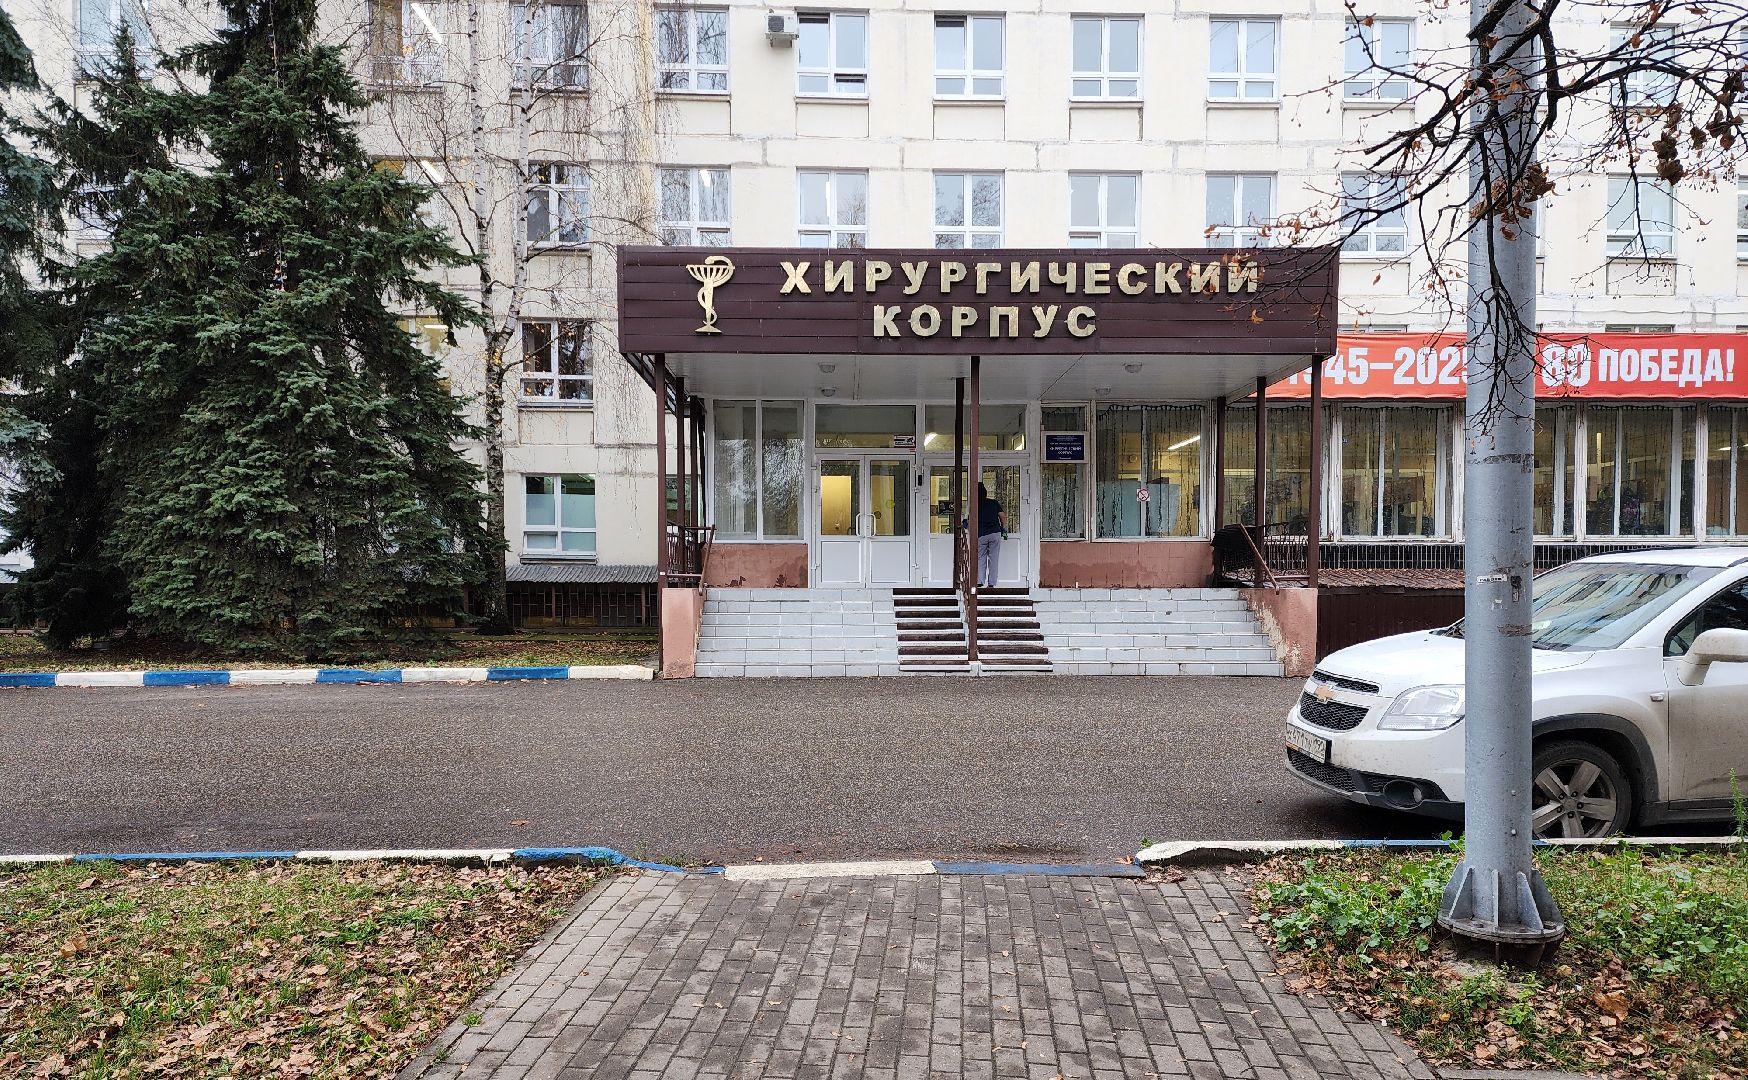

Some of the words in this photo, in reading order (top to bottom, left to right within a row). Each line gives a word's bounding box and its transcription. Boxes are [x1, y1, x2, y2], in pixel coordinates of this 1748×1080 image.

[873, 304, 1097, 338] КОРПУС
[1288, 346, 1467, 385] 45–202
[1542, 343, 1591, 387] 80
[1598, 348, 1735, 388] ПОБЕДА!
